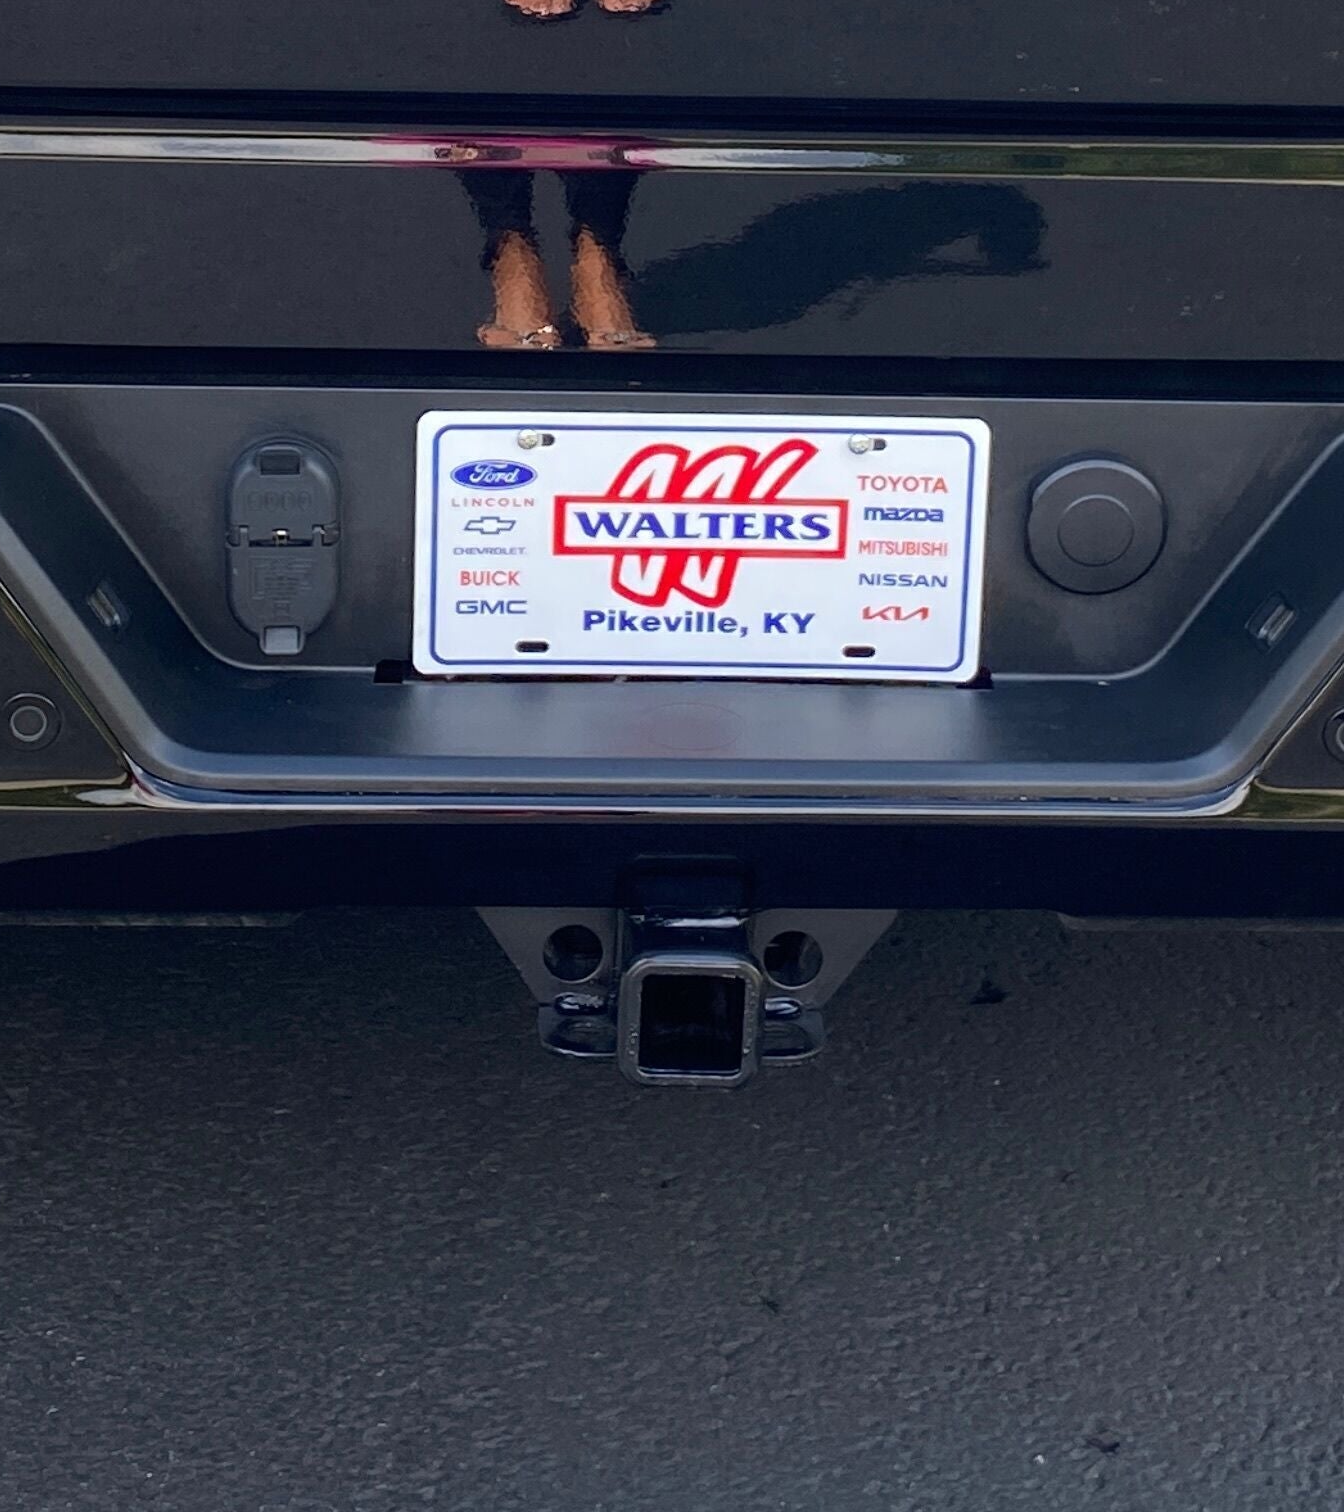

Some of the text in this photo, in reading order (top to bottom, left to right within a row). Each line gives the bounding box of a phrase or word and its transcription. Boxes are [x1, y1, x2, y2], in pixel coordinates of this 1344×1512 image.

[857, 474, 949, 494] TOYOTA
[450, 497, 535, 508] LINCOLN
[573, 511, 832, 542] WALTERS
[857, 539, 949, 557] MITSUBISHI
[459, 570, 521, 587] BUICK
[858, 572, 949, 588] NISSAN
[455, 599, 528, 615] GMC
[582, 609, 816, 638] Pikeville, KY
